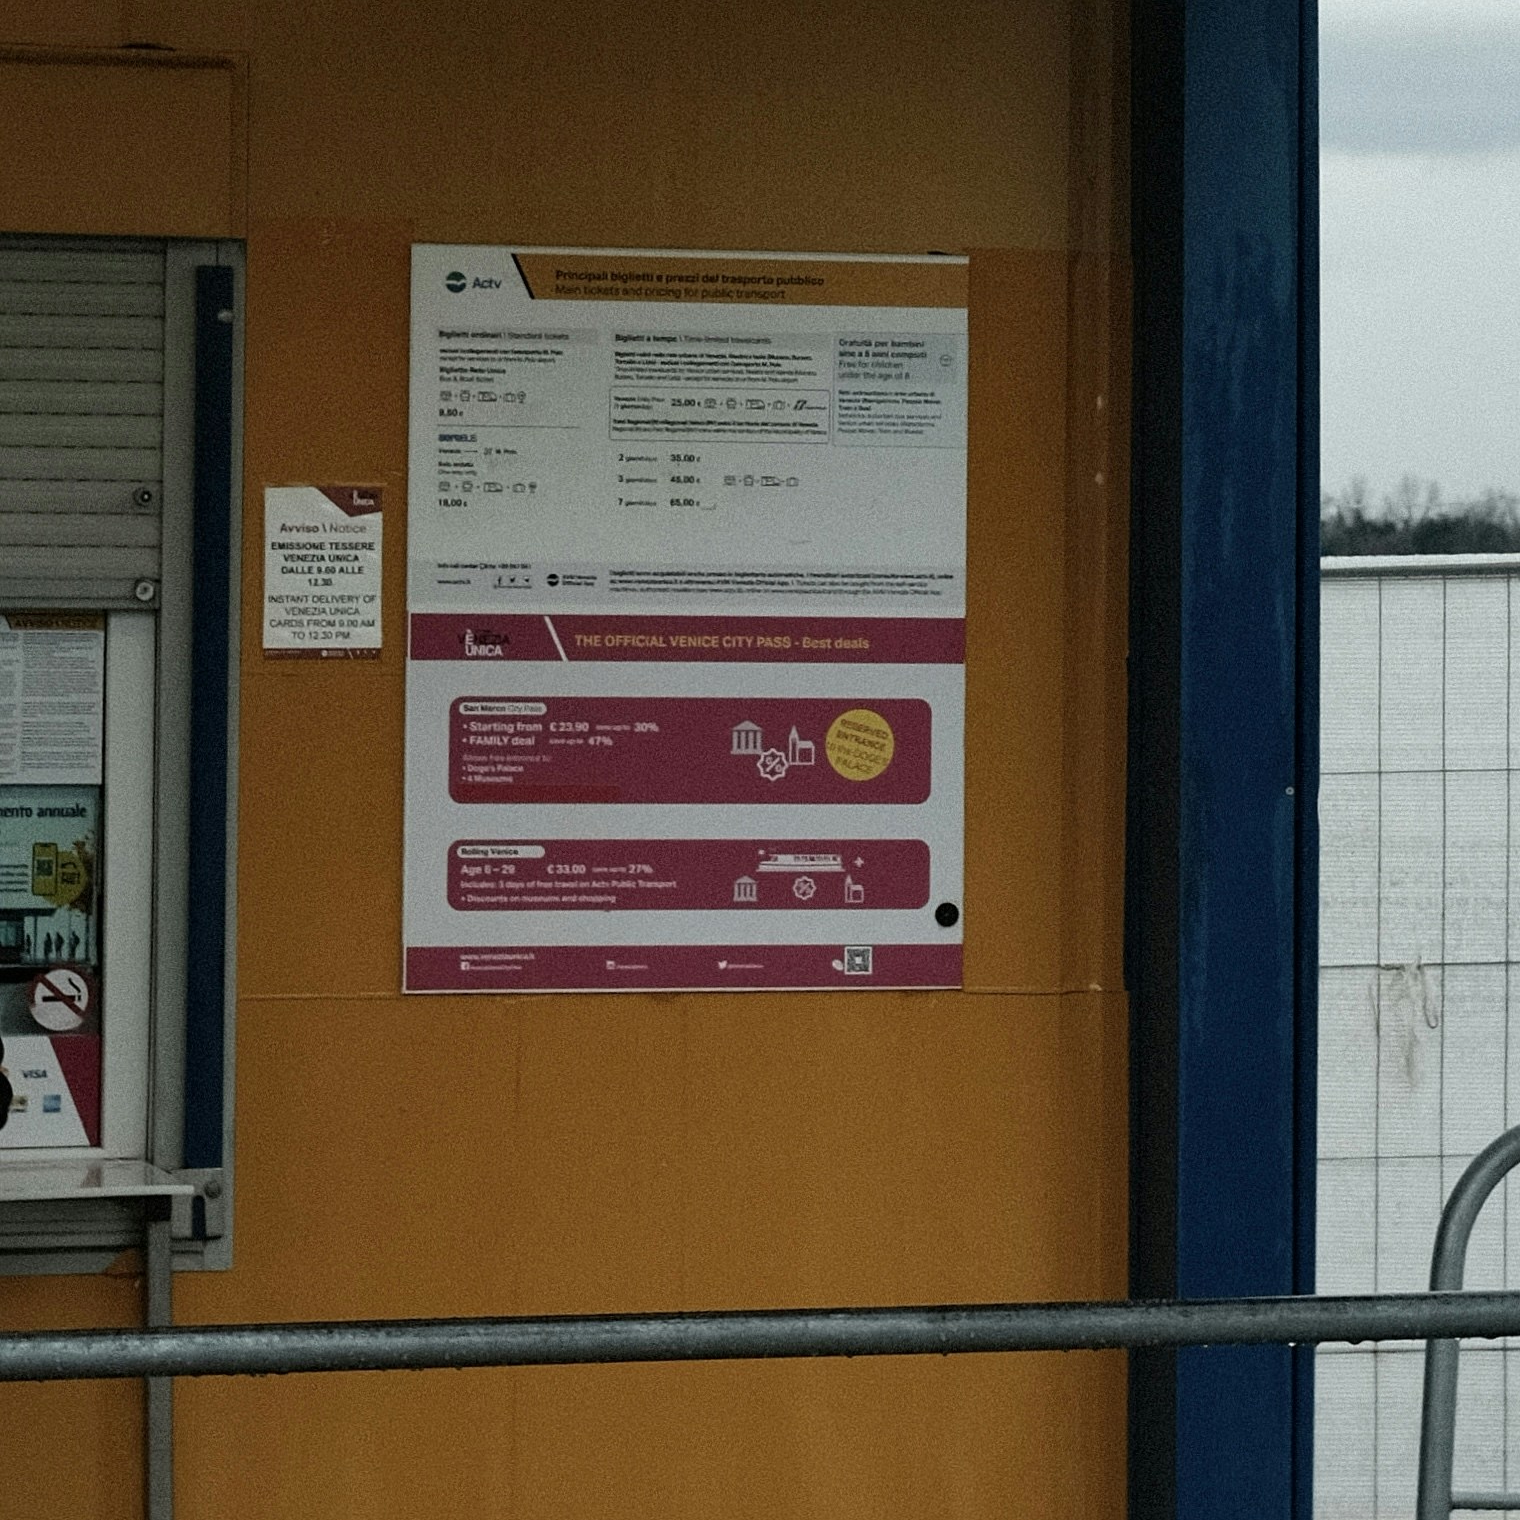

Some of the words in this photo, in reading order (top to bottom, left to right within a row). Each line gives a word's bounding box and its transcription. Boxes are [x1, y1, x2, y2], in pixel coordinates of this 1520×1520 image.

[472, 276, 503, 292] Actv
[555, 269, 608, 283] Principali
[611, 271, 654, 284] biglietti
[655, 274, 664, 282] e
[666, 273, 699, 285] prezzi
[722, 275, 774, 287] trasporto
[776, 277, 824, 288] pubblico
[555, 285, 581, 295] Main
[583, 286, 620, 296] tickets
[621, 287, 643, 296] and
[645, 287, 681, 299] pricing
[683, 288, 699, 297] for
[701, 288, 734, 300] public
[736, 290, 786, 301] transport
[615, 334, 645, 344] Biglietti
[280, 522, 320, 535] Avviso
[329, 523, 368, 535] Notice
[270, 541, 327, 551] EMISSIONE
[329, 541, 376, 551] TESSERE
[283, 553, 327, 563] VENEZIA
[328, 553, 360, 563] UNICA
[281, 565, 314, 576] DALLE
[338, 565, 366, 575] ALLE
[268, 594, 310, 604] INSTANT
[311, 594, 361, 604] DELIVERY
[362, 594, 377, 604] OF
[283, 606, 328, 617] VENEZIA
[329, 606, 361, 617] UNICA
[269, 619, 305, 629] CARDS
[306, 619, 337, 629] FROM
[360, 619, 376, 628] AM
[292, 631, 307, 641] TO
[336, 631, 352, 641] PM
[574, 634, 601, 647] THE
[604, 634, 666, 648] OFFICIAL
[669, 635, 719, 649] VENICE
[722, 635, 753, 649] CITY
[756, 636, 791, 649] PASS
[802, 636, 833, 649] Best
[834, 637, 870, 650] deals
[464, 644, 504, 657] UNICA
[463, 704, 479, 712] San
[469, 721, 515, 734] Starting
[516, 721, 543, 732] from
[633, 721, 660, 733] 30%
[840, 718, 889, 740] RESERVED
[469, 735, 510, 746] FAMILY
[511, 735, 536, 746] deal
[588, 736, 614, 747] 47%
[836, 729, 886, 752] ENTRANCE
[834, 755, 874, 775] PALACE
[0, 806, 33, 818] ento
[37, 803, 87, 818] annuale
[461, 847, 489, 858] Rolling
[490, 847, 519, 856] Venice
[460, 864, 482, 877] Age
[556, 864, 587, 875] 33.00
[628, 863, 654, 875] 27%
[637, 880, 677, 890] Transport
[22, 1069, 48, 1079] VISA
